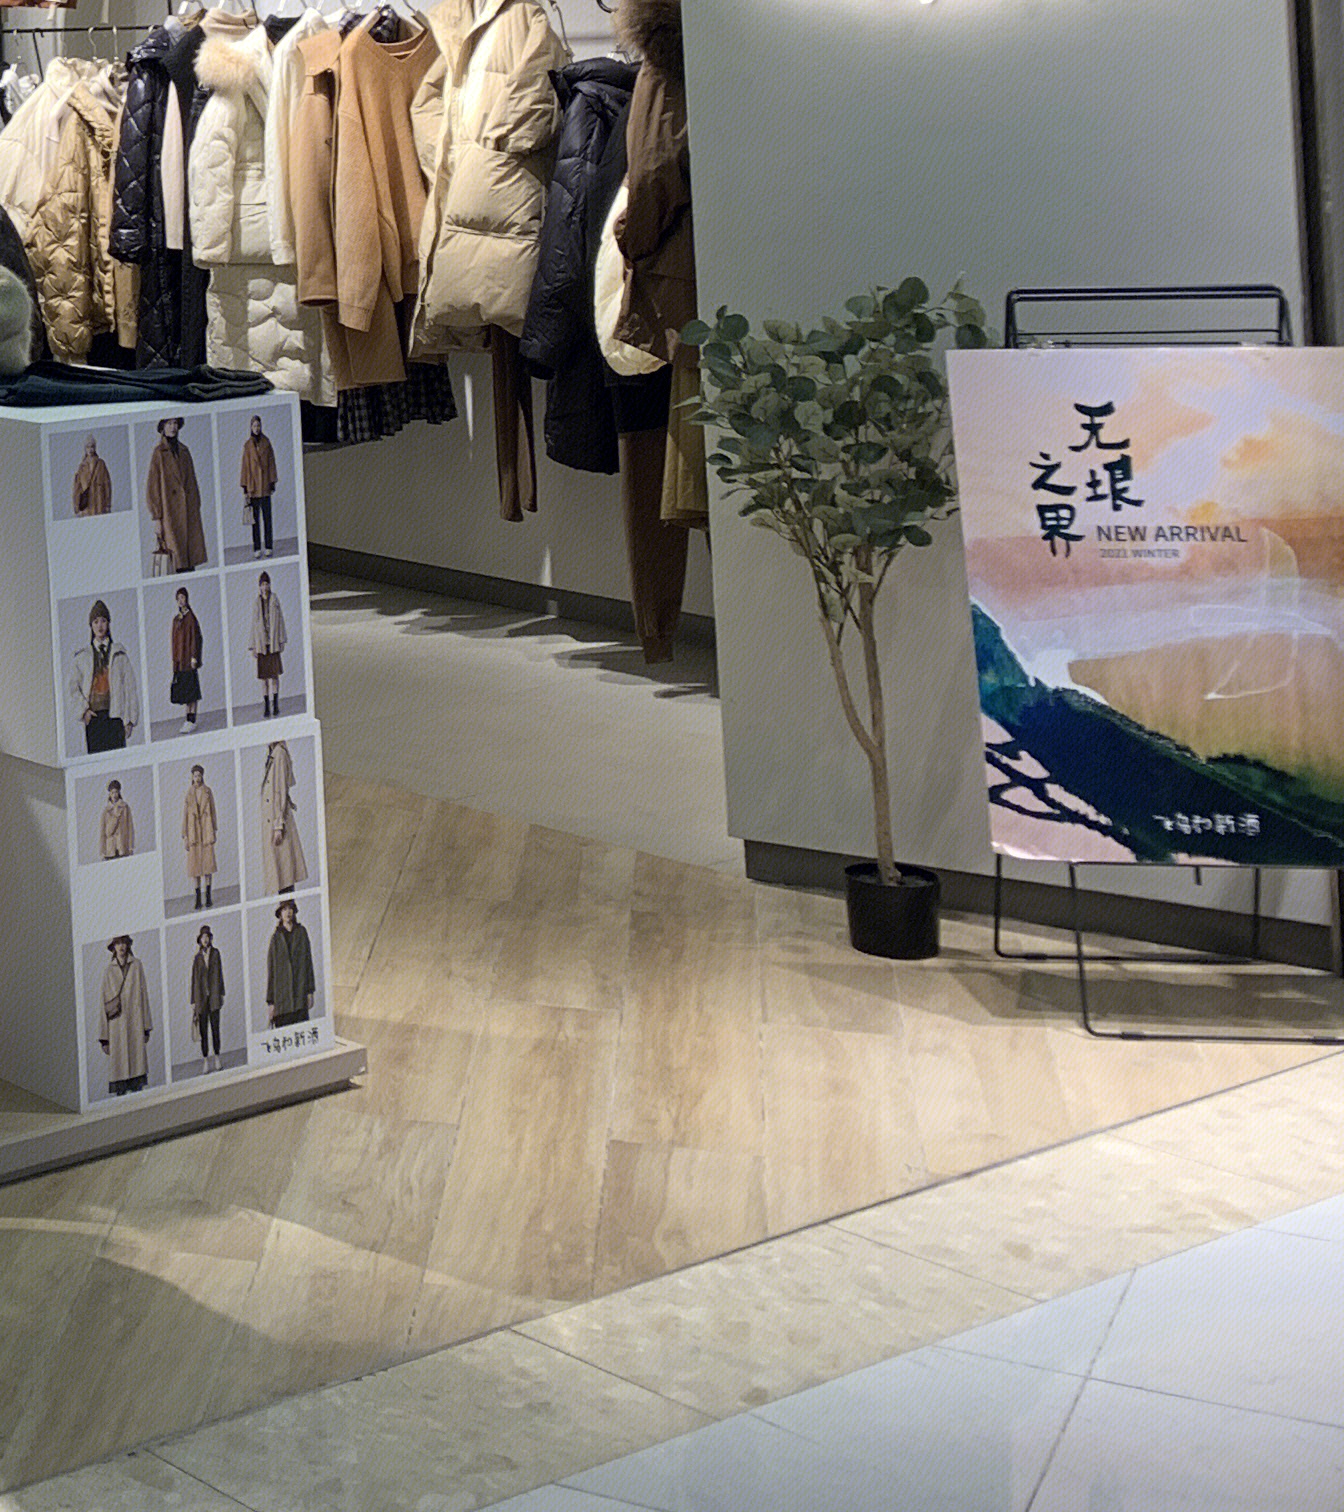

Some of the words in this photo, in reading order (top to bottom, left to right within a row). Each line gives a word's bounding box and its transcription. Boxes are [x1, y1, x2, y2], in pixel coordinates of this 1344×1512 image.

[1096, 524, 1148, 542] NEW
[1154, 525, 1248, 543] ARRIVAL
[1098, 548, 1128, 559] 2021
[1132, 548, 1180, 559] WINTER
